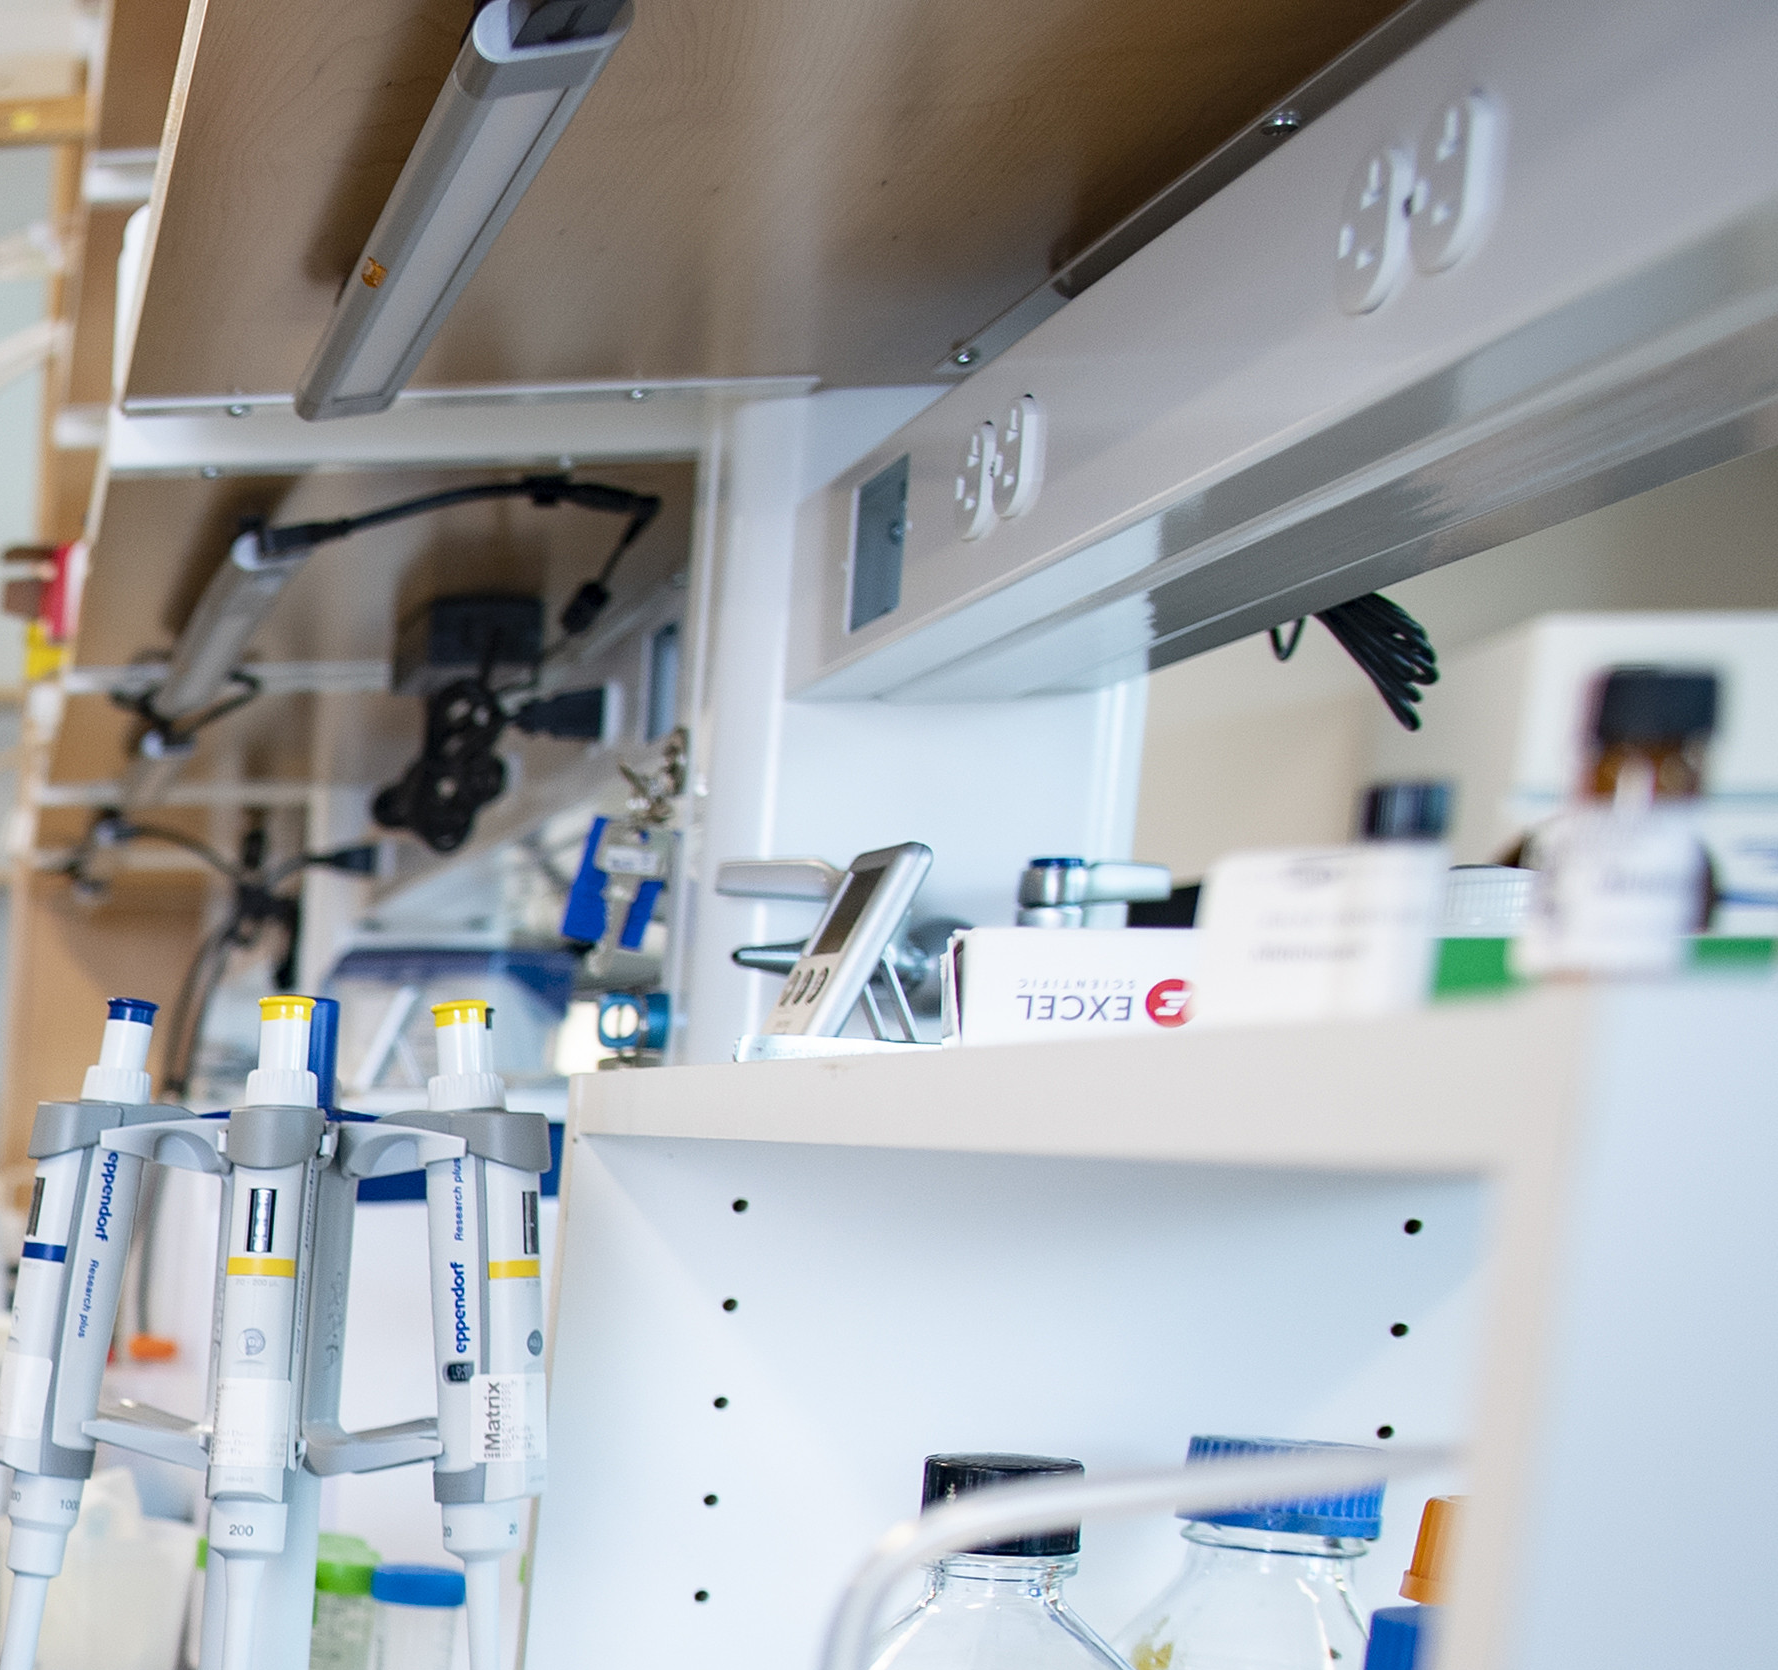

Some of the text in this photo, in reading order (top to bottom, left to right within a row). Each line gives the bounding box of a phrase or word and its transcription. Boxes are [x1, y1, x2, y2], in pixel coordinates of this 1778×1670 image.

[1016, 995, 1133, 1022] EXCEL
[1017, 979, 1138, 991] SCIENTIFIC
[94, 1151, 120, 1242] eppendorf
[452, 1186, 465, 1241] Research
[77, 1259, 100, 1339] Research plus
[450, 1261, 471, 1354] eppendorf
[483, 1381, 501, 1451] Matrix
[228, 1525, 254, 1537] 200
